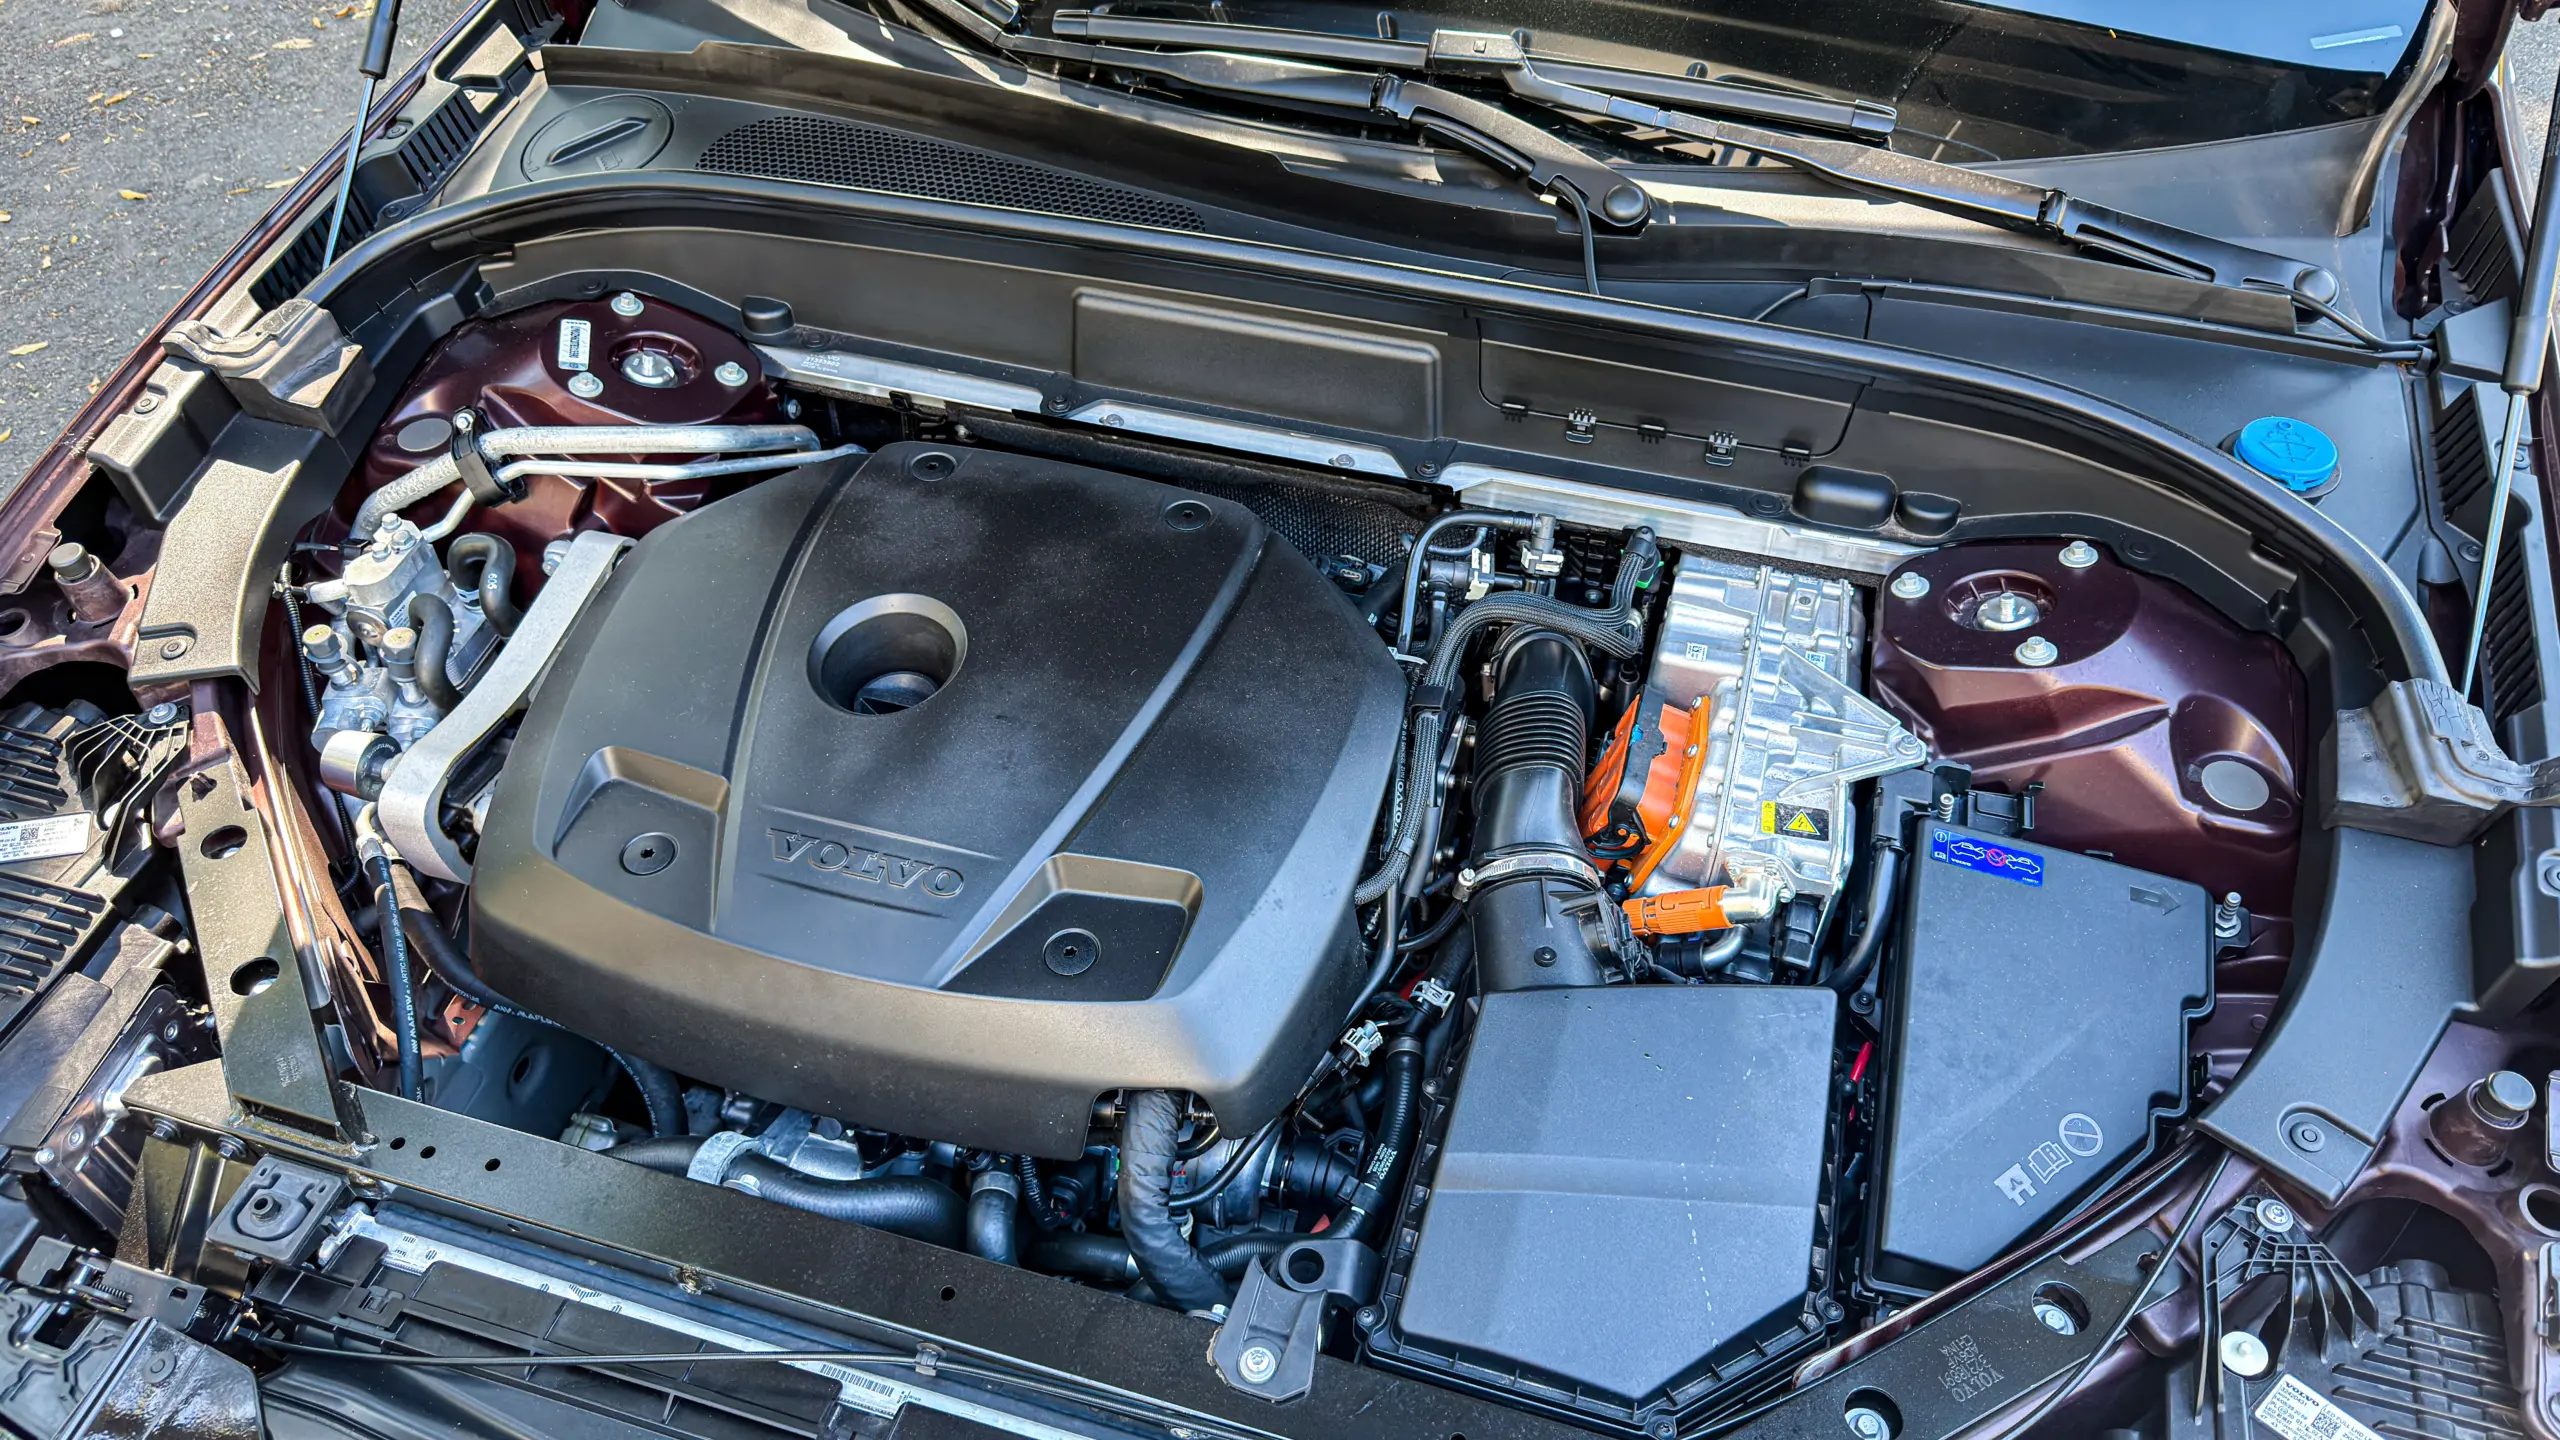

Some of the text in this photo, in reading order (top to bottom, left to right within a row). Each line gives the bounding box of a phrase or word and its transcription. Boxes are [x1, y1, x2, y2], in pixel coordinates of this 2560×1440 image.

[487, 573, 498, 589] 606
[767, 828, 964, 898] VOLVO
[1379, 1150, 1398, 1180] VOLVO
[1938, 1334, 1974, 1357] CHINA
[1951, 1367, 2004, 1402] VOLVO
[2284, 1381, 2319, 1407] VOLVO
